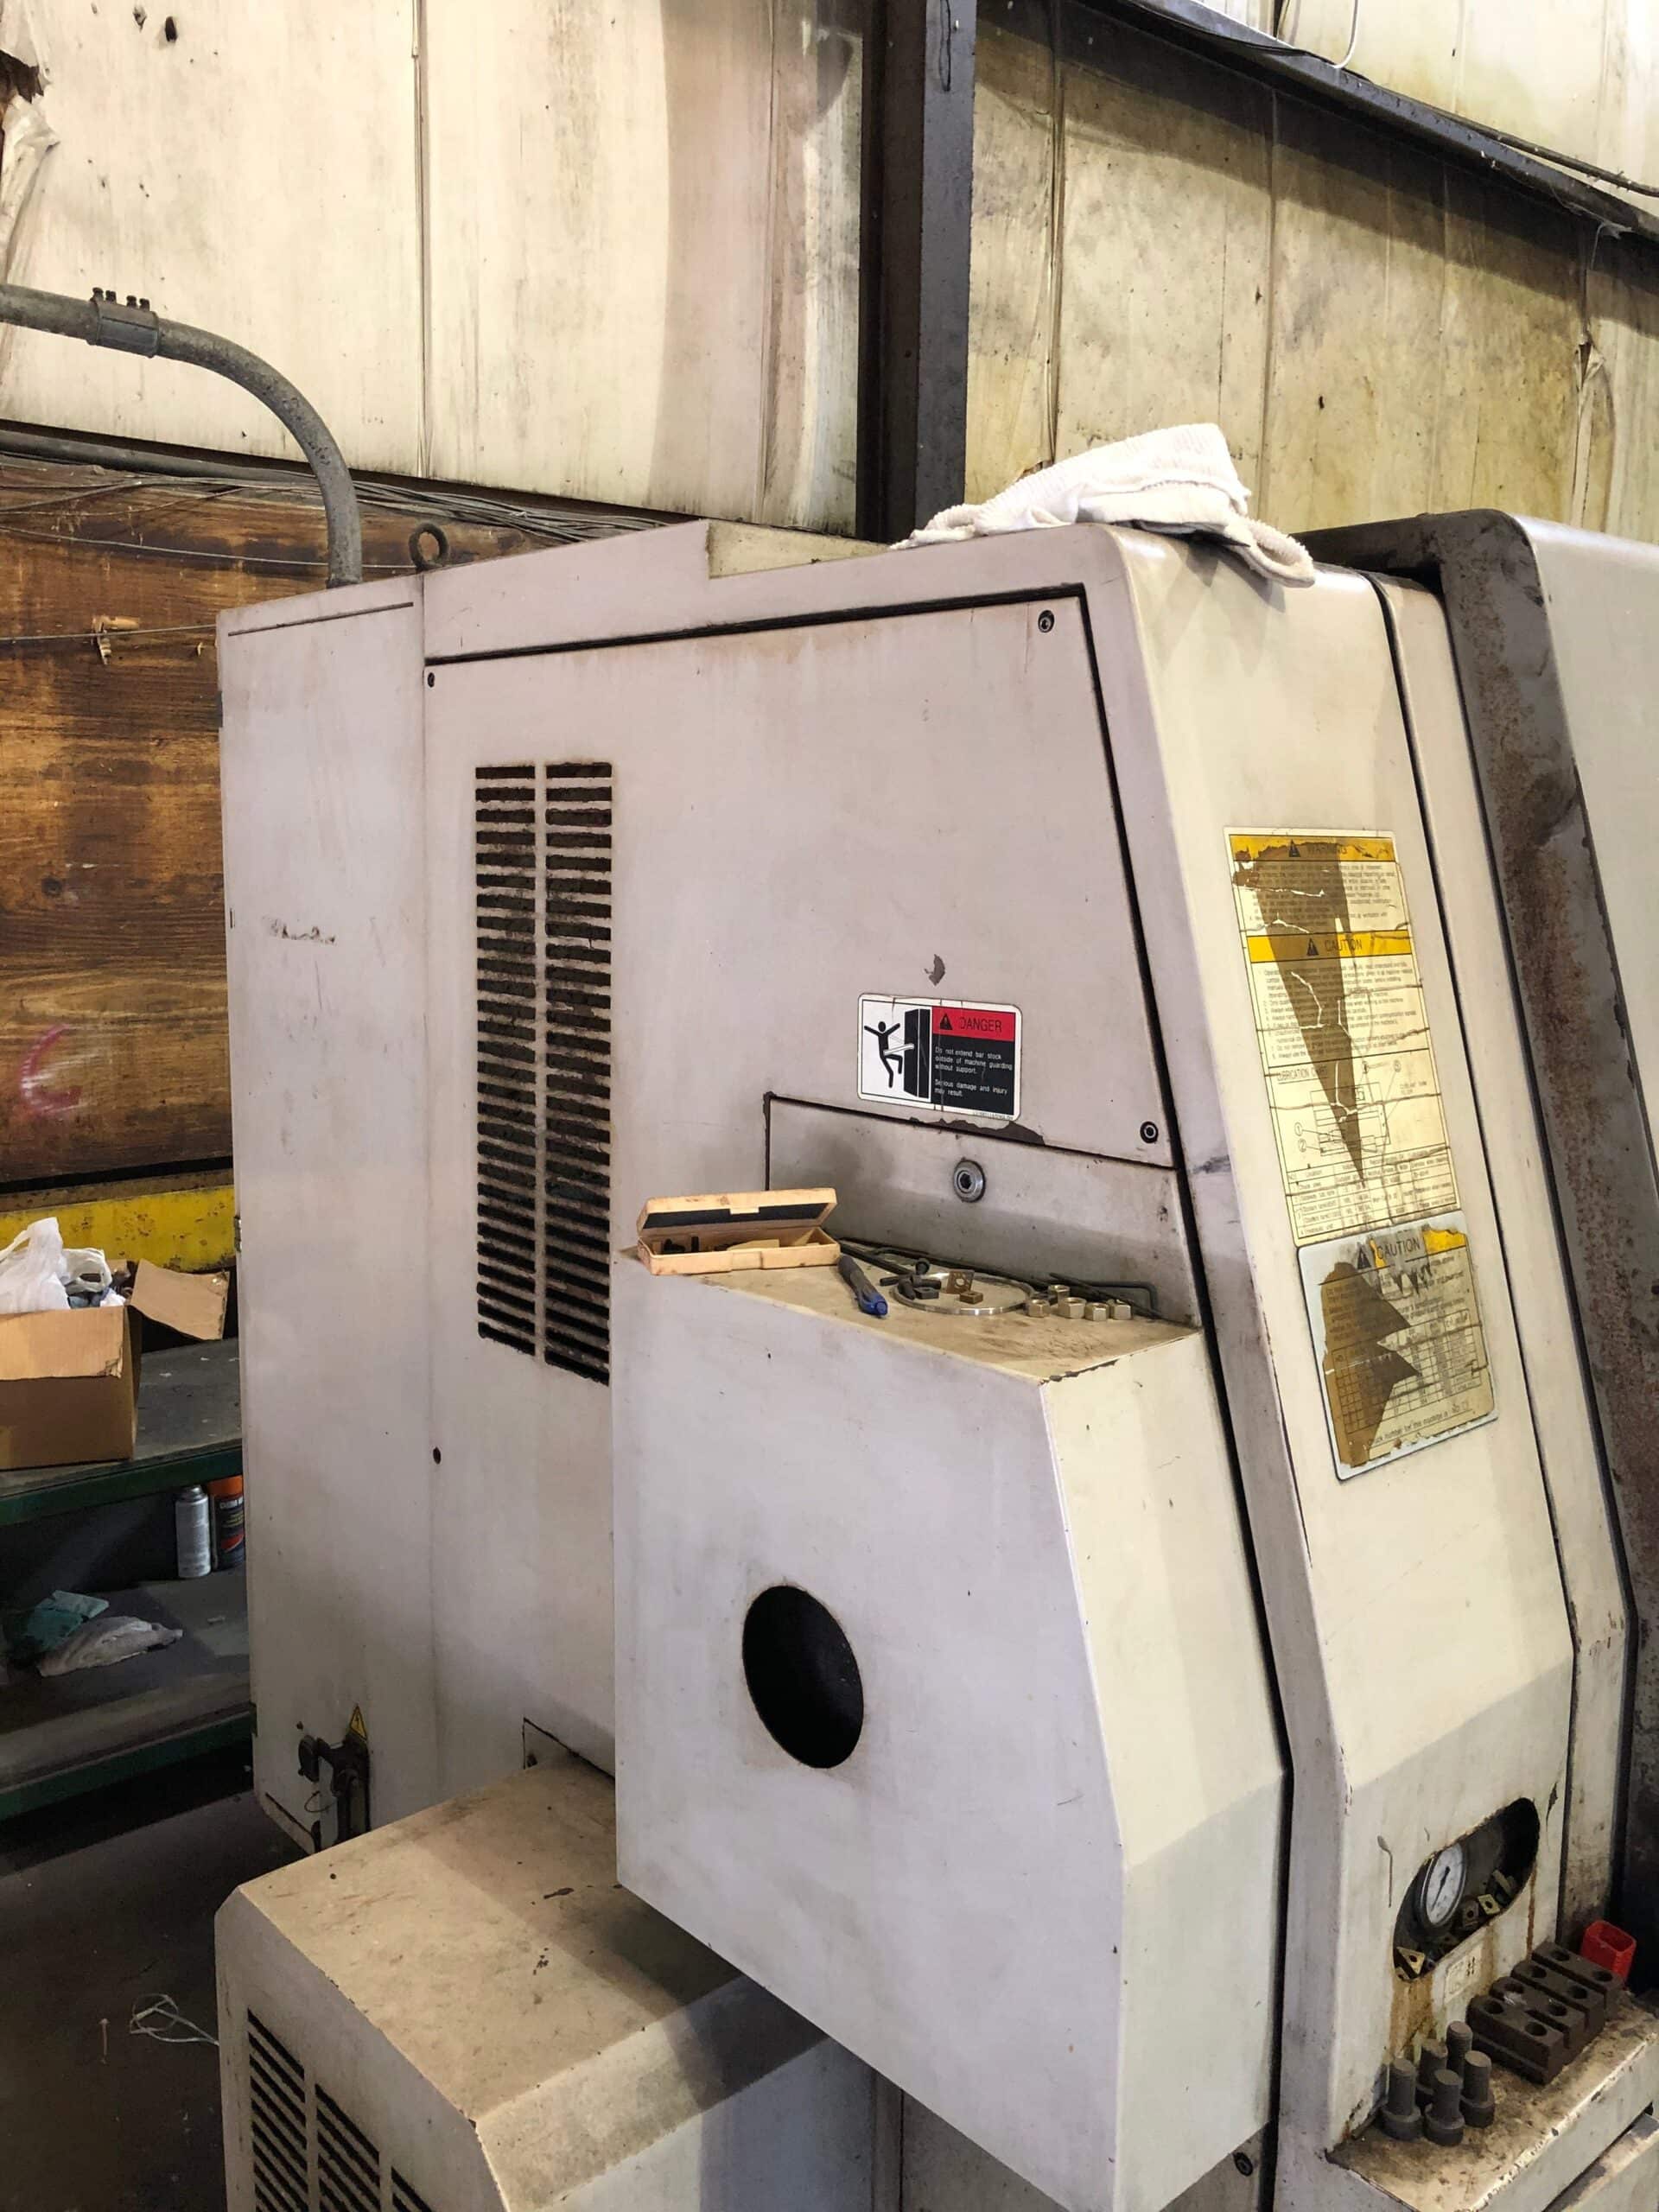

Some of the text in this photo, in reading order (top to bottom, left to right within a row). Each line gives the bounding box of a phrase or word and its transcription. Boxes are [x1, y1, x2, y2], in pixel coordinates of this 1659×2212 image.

[1325, 938, 1363, 951] CAUTION
[959, 1016, 1002, 1033] DANGER
[988, 1062, 1013, 1071] guarding
[935, 1078, 954, 1087] Serious
[957, 1082, 977, 1090] damage
[993, 1087, 1007, 1096] injury
[1377, 1237, 1421, 1259] CAUTION
